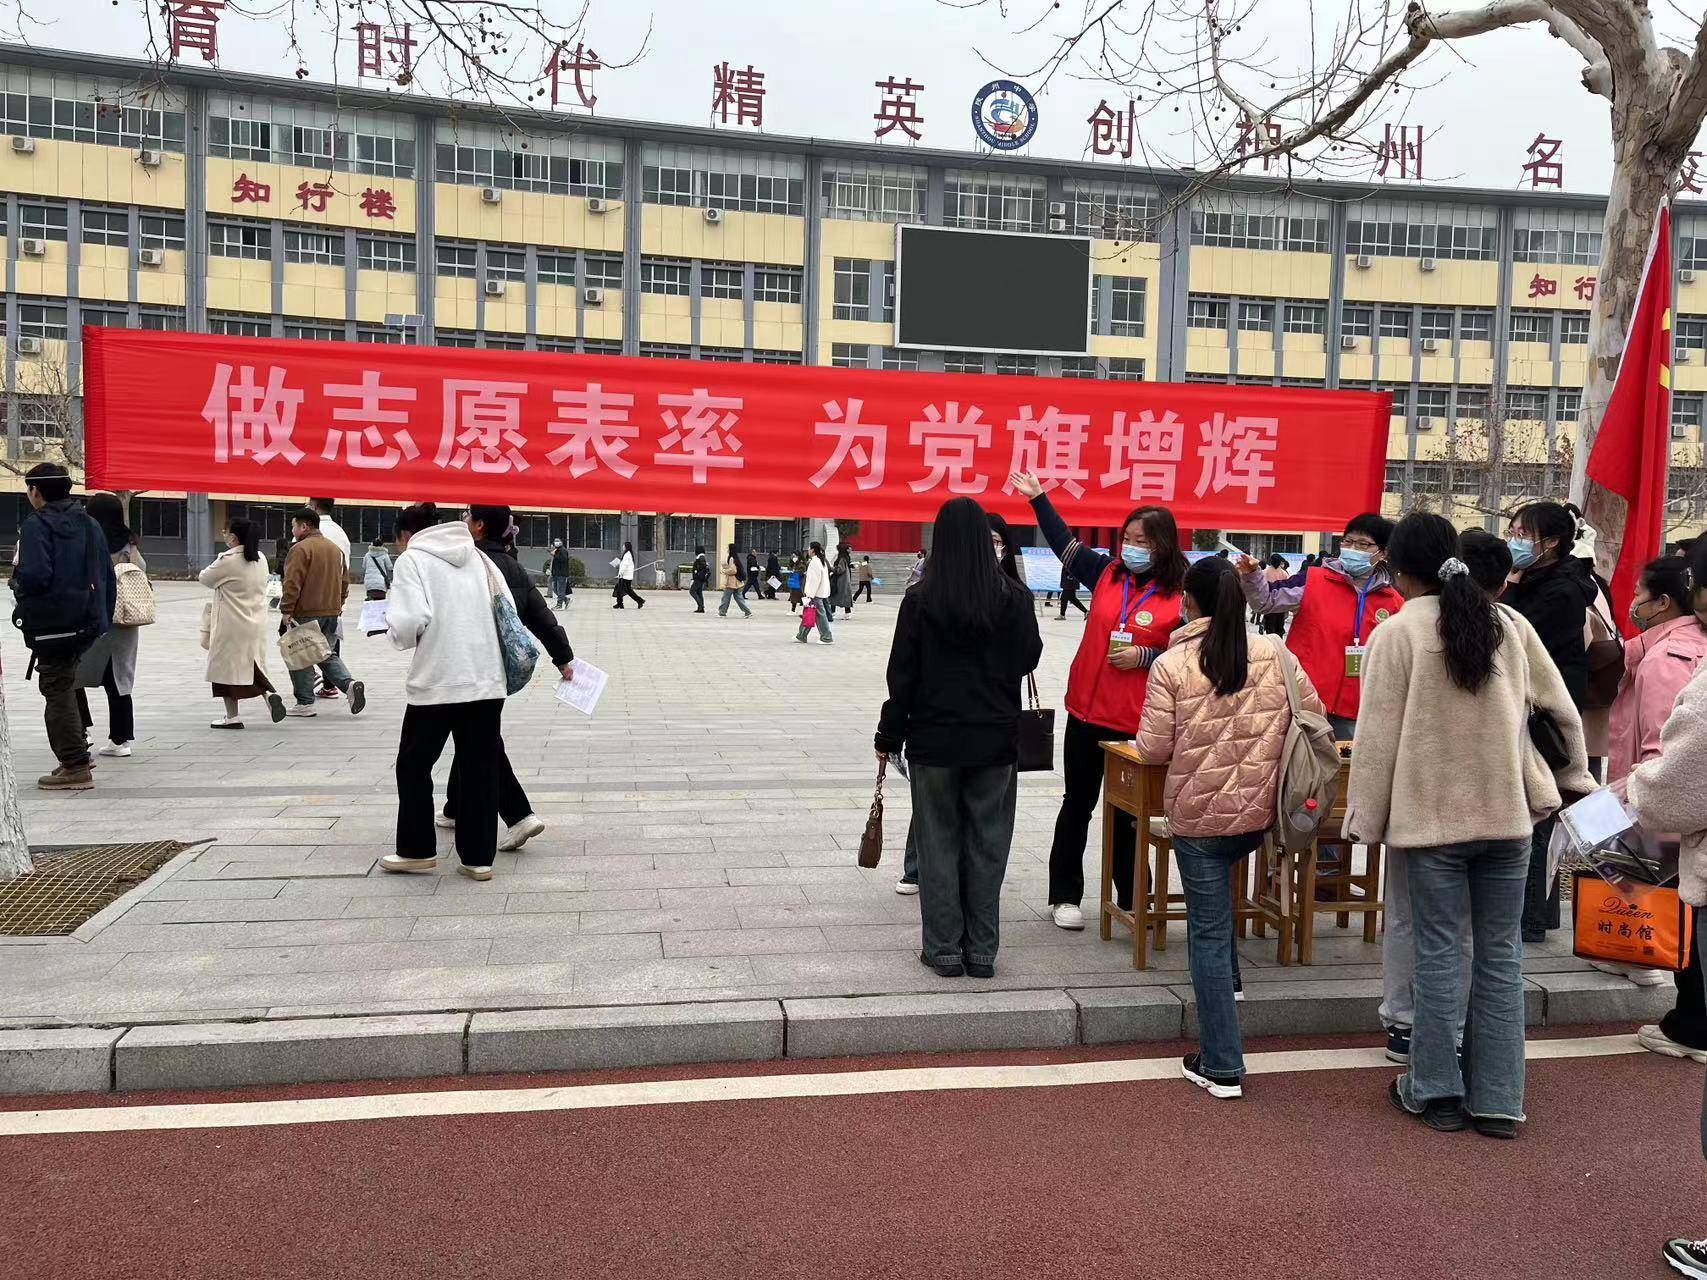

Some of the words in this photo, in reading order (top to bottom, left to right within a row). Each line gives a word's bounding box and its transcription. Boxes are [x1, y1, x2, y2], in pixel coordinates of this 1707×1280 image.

[232, 173, 397, 220] 知行楼
[1528, 273, 1597, 301] 知行
[201, 362, 745, 485] 做志愿表率
[808, 397, 1280, 504] 为党旗增辉
[1598, 919, 1655, 940] 时尚馆
